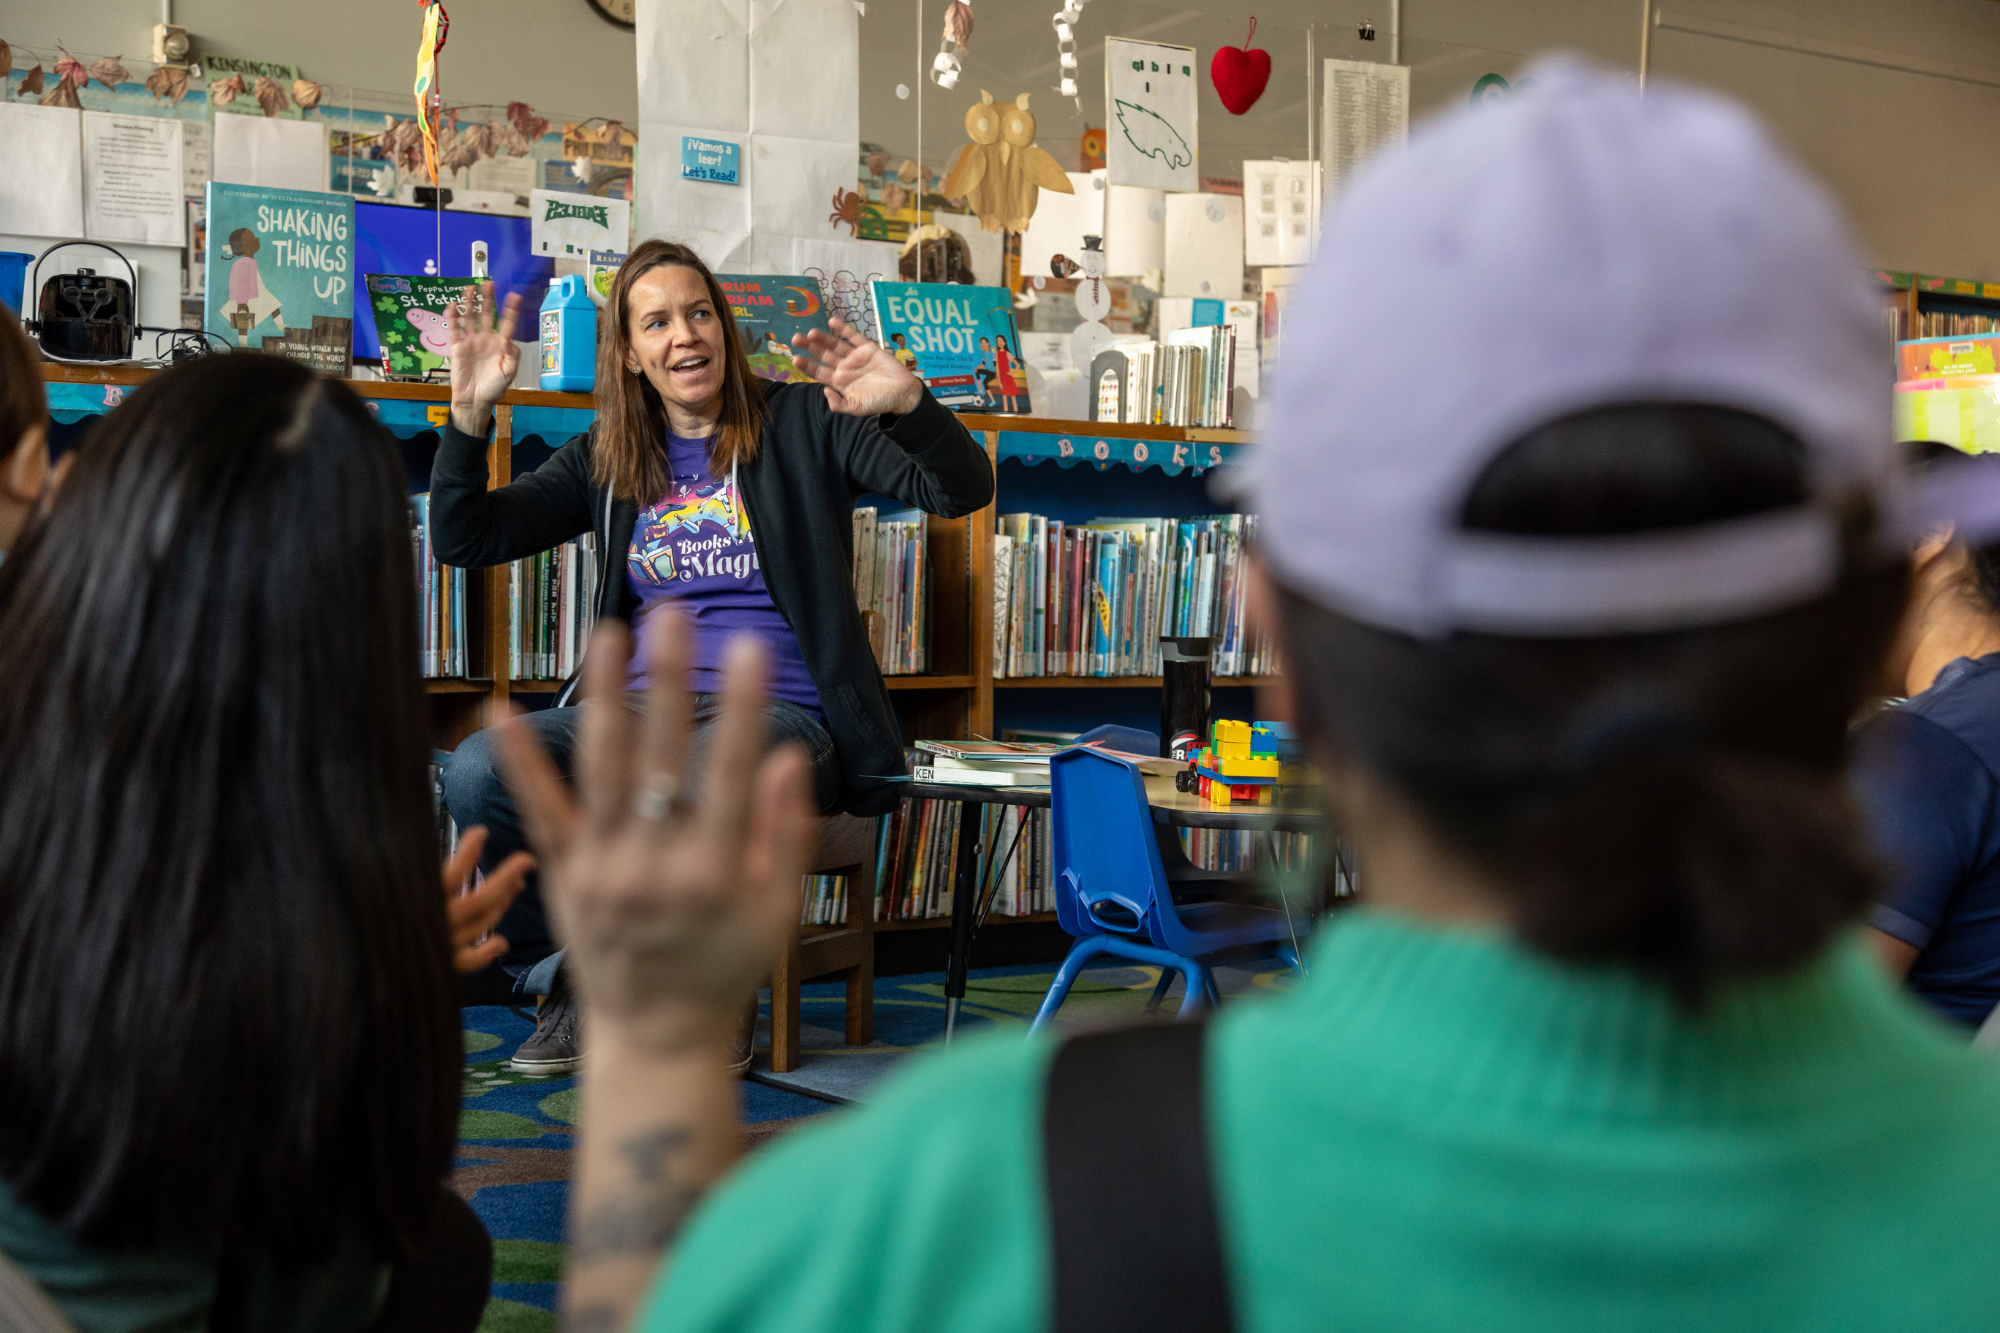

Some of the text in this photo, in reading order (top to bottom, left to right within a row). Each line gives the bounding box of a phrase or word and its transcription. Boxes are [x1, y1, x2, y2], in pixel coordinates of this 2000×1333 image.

[206, 56, 291, 79] KENSINGTON
[726, 146, 732, 155] a
[698, 152, 722, 166] leer!
[683, 165, 736, 182] Let's Read!
[596, 255, 622, 263] READY
[314, 275, 347, 305] UP
[418, 285, 443, 293] Peppa
[905, 287, 919, 297] An
[400, 293, 484, 307] St. Patric's
[726, 295, 774, 306] REAM
[456, 304, 482, 316] Dy
[887, 296, 979, 325] EQUAL
[908, 326, 975, 354] SHOT
[288, 343, 309, 351] YOUNG
[313, 353, 324, 361] THE
[677, 534, 731, 555] Books
[680, 549, 760, 583] Magi
[916, 768, 935, 779] KEN
